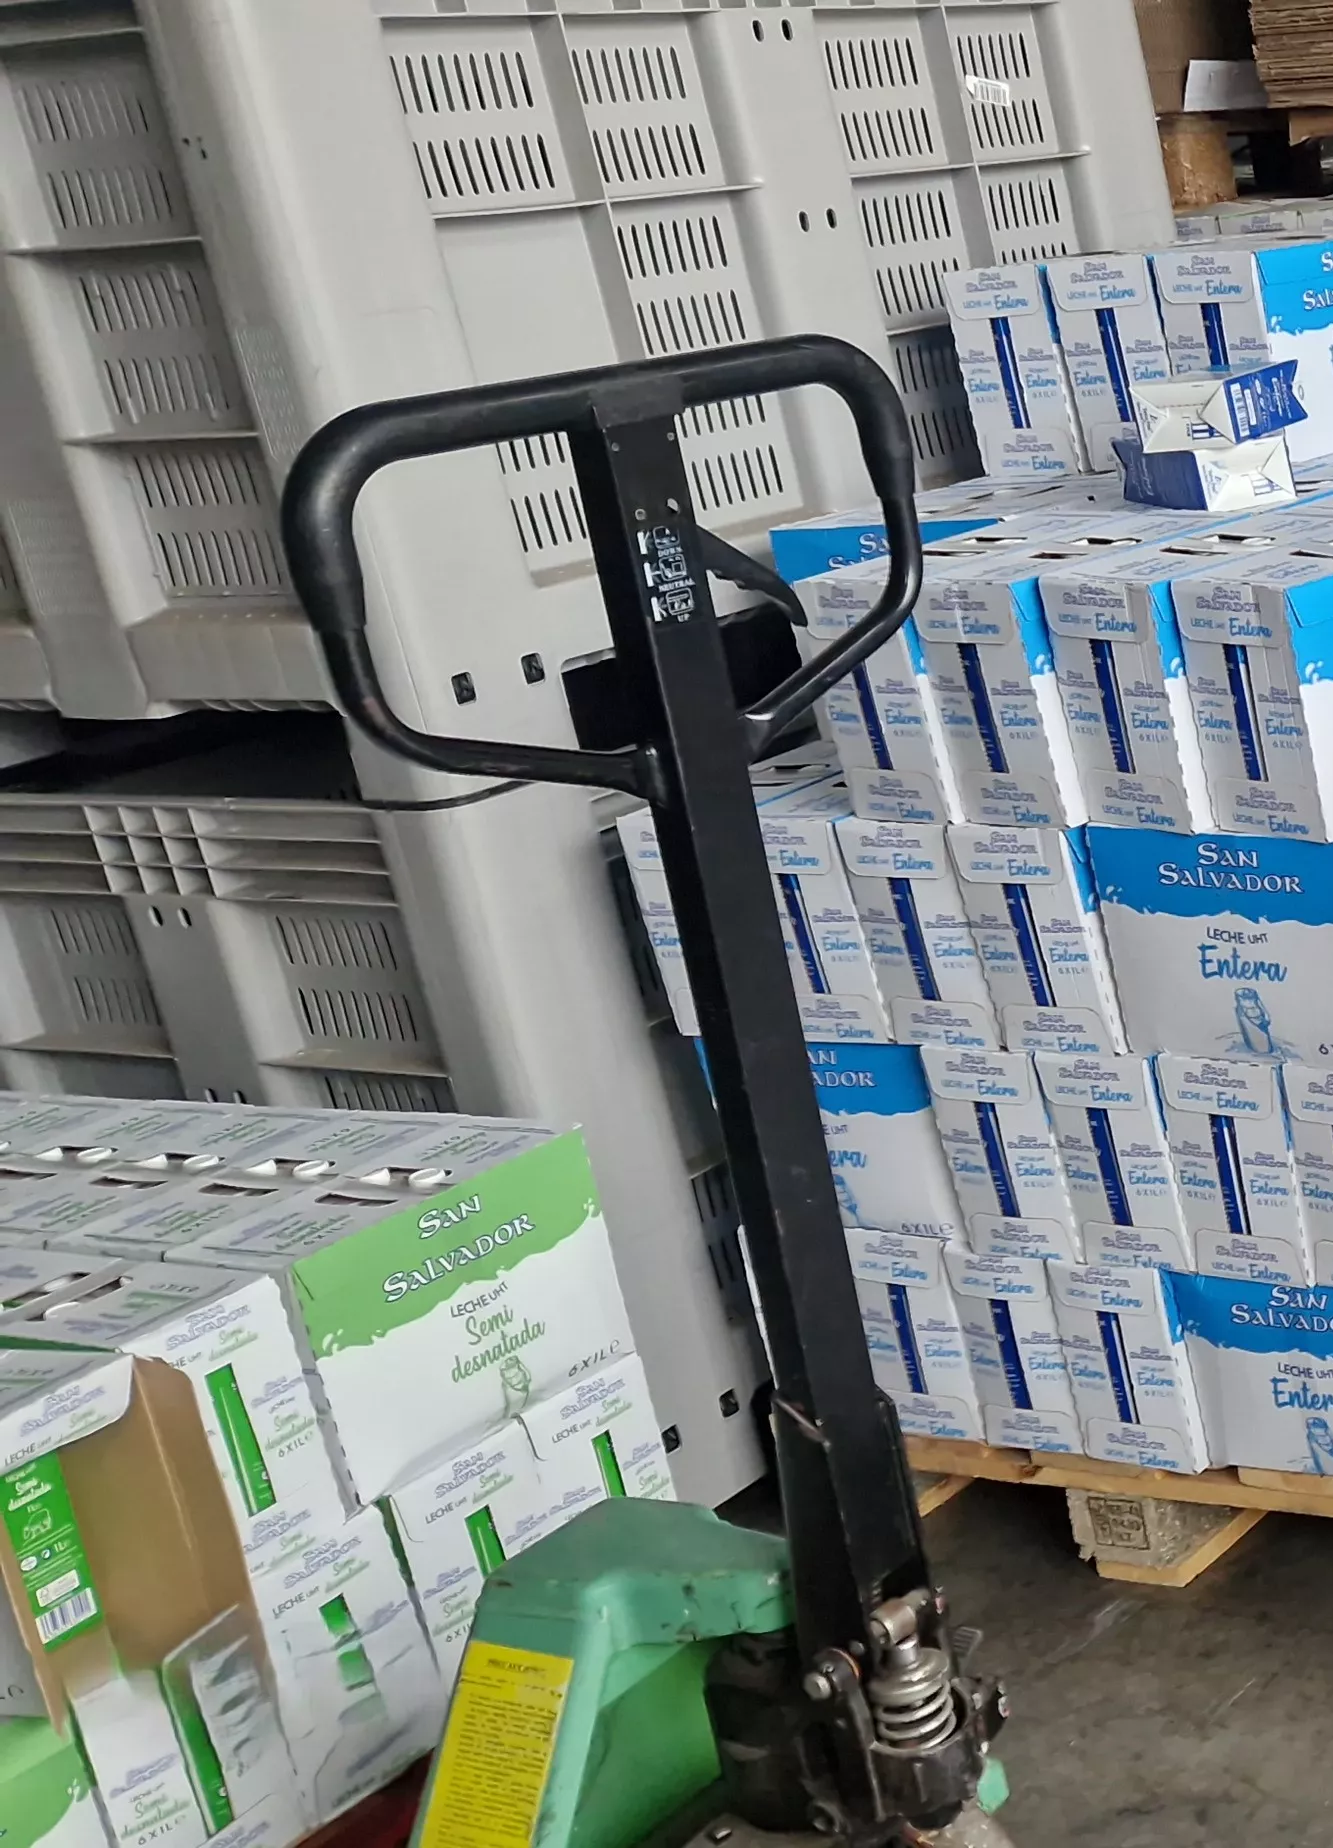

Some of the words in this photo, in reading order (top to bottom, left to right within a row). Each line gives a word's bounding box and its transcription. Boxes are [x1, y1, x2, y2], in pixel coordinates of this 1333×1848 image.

[1197, 843, 1259, 868] SAN
[1158, 863, 1304, 894] SALVADOR
[1206, 926, 1246, 945] LECHE
[1198, 945, 1287, 983] Entera
[809, 1049, 837, 1065] AN
[417, 1193, 482, 1240] SAN
[381, 1211, 536, 1303] SALVADOR
[449, 1292, 489, 1317] LECHE
[1268, 1286, 1328, 1310] SAN
[465, 1305, 515, 1347] Semi
[450, 1317, 547, 1383] desnatada
[1277, 1363, 1314, 1378] LECHE
[552, 1424, 579, 1443] LECHE
[5, 1443, 36, 1466] LECHE
[425, 1502, 454, 1524] LECHE
[272, 1592, 305, 1618] LECHE
